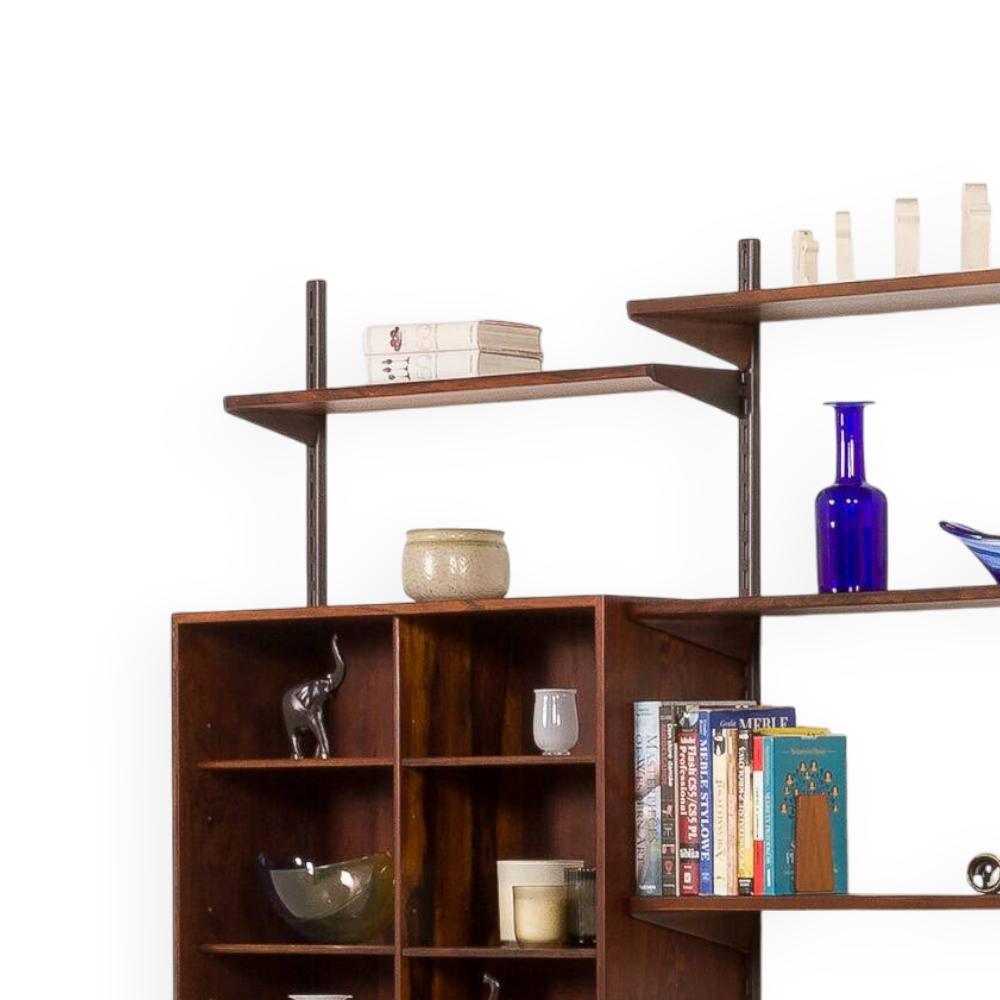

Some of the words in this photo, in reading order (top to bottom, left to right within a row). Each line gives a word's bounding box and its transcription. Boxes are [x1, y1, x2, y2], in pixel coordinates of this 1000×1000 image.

[679, 745, 688, 815] Professional
[687, 745, 697, 775] Flash
[699, 739, 709, 788] MEBLE
[686, 777, 697, 824] CS5/CS5
[687, 826, 697, 840] PL
[700, 791, 710, 861] STYLOWE
